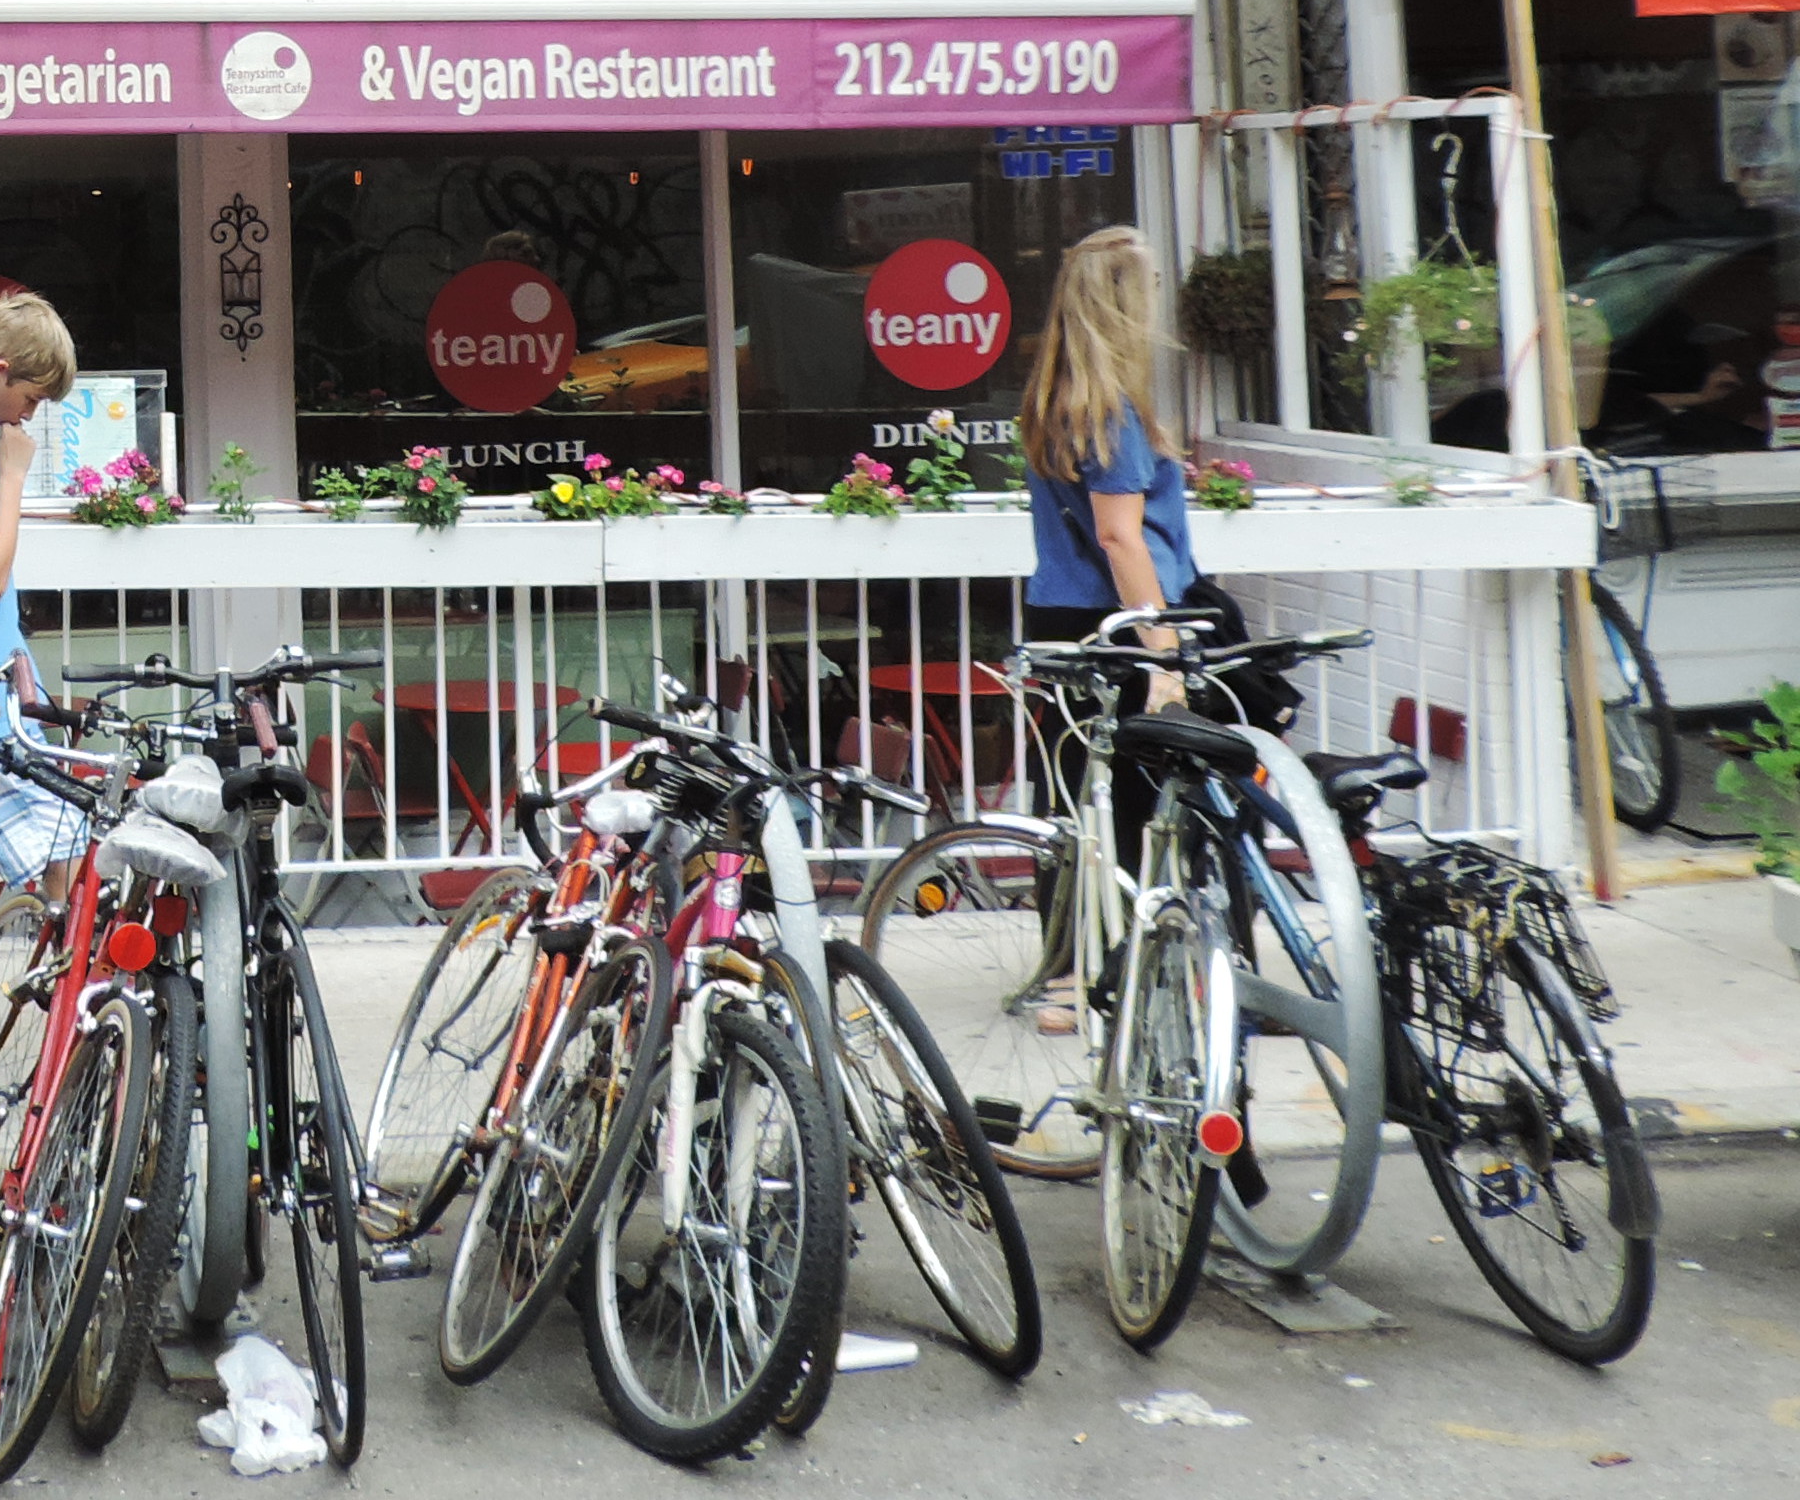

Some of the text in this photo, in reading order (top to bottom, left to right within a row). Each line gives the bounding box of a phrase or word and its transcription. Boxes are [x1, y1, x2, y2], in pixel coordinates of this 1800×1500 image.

[225, 67, 286, 83] Teanyssimo
[359, 43, 777, 116] & Vegan Restaurant
[834, 39, 1120, 96] 212.475.9190
[226, 82, 308, 95] Restaurant Cafe
[1001, 148, 1115, 179] WI-FI
[868, 307, 1000, 354] teany
[432, 329, 564, 374] teany
[440, 439, 586, 468] LUNCH
